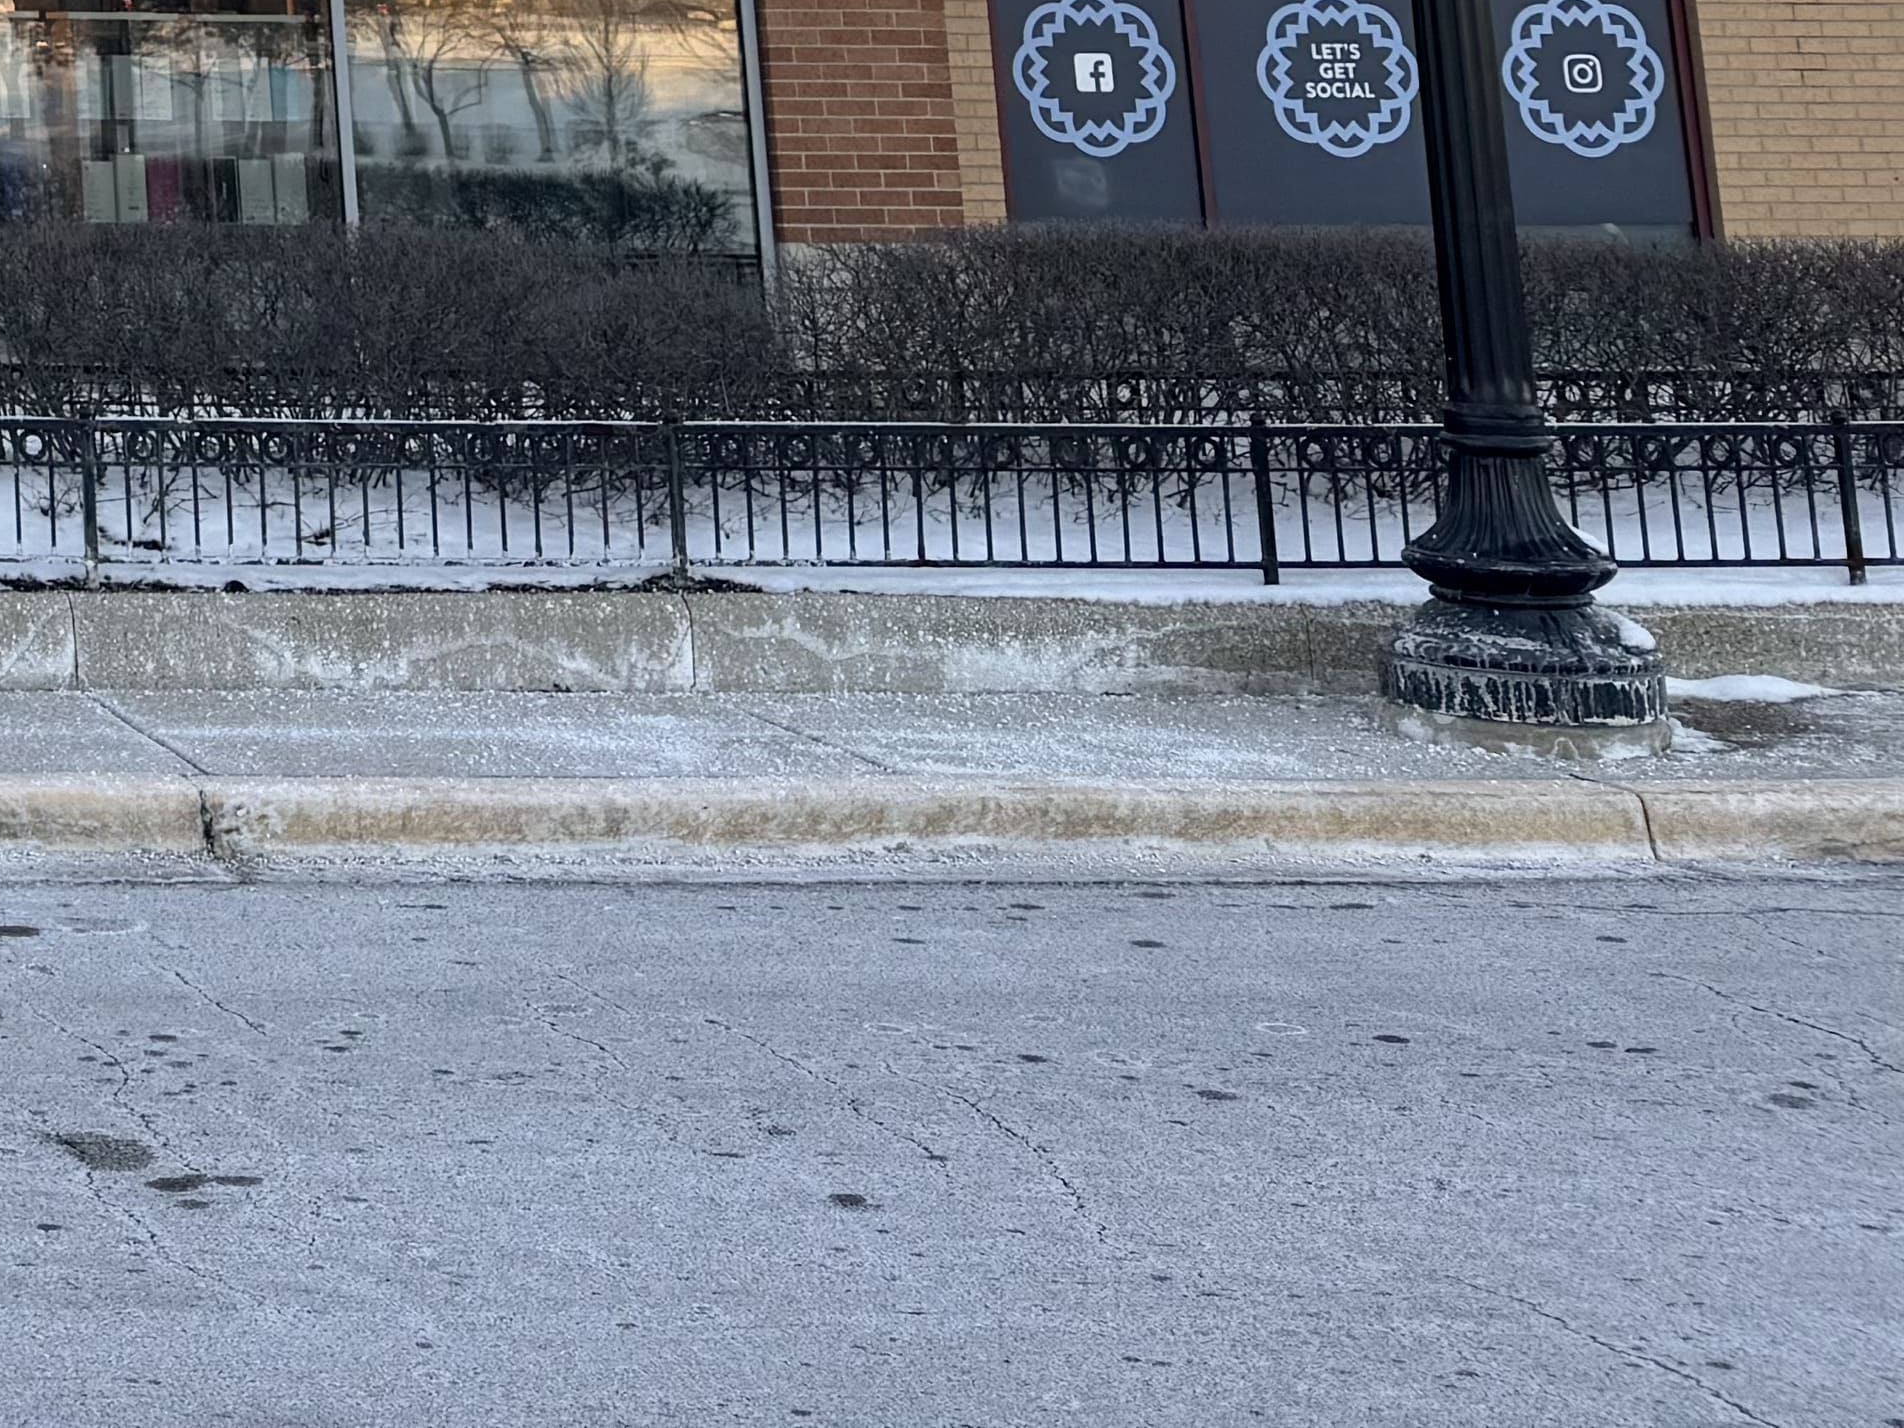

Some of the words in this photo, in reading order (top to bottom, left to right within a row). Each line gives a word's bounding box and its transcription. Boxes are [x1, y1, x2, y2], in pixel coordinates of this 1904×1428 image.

[1310, 43, 1361, 60] LET'S
[1319, 63, 1356, 80] GET
[1305, 82, 1375, 99] SOCIAL
